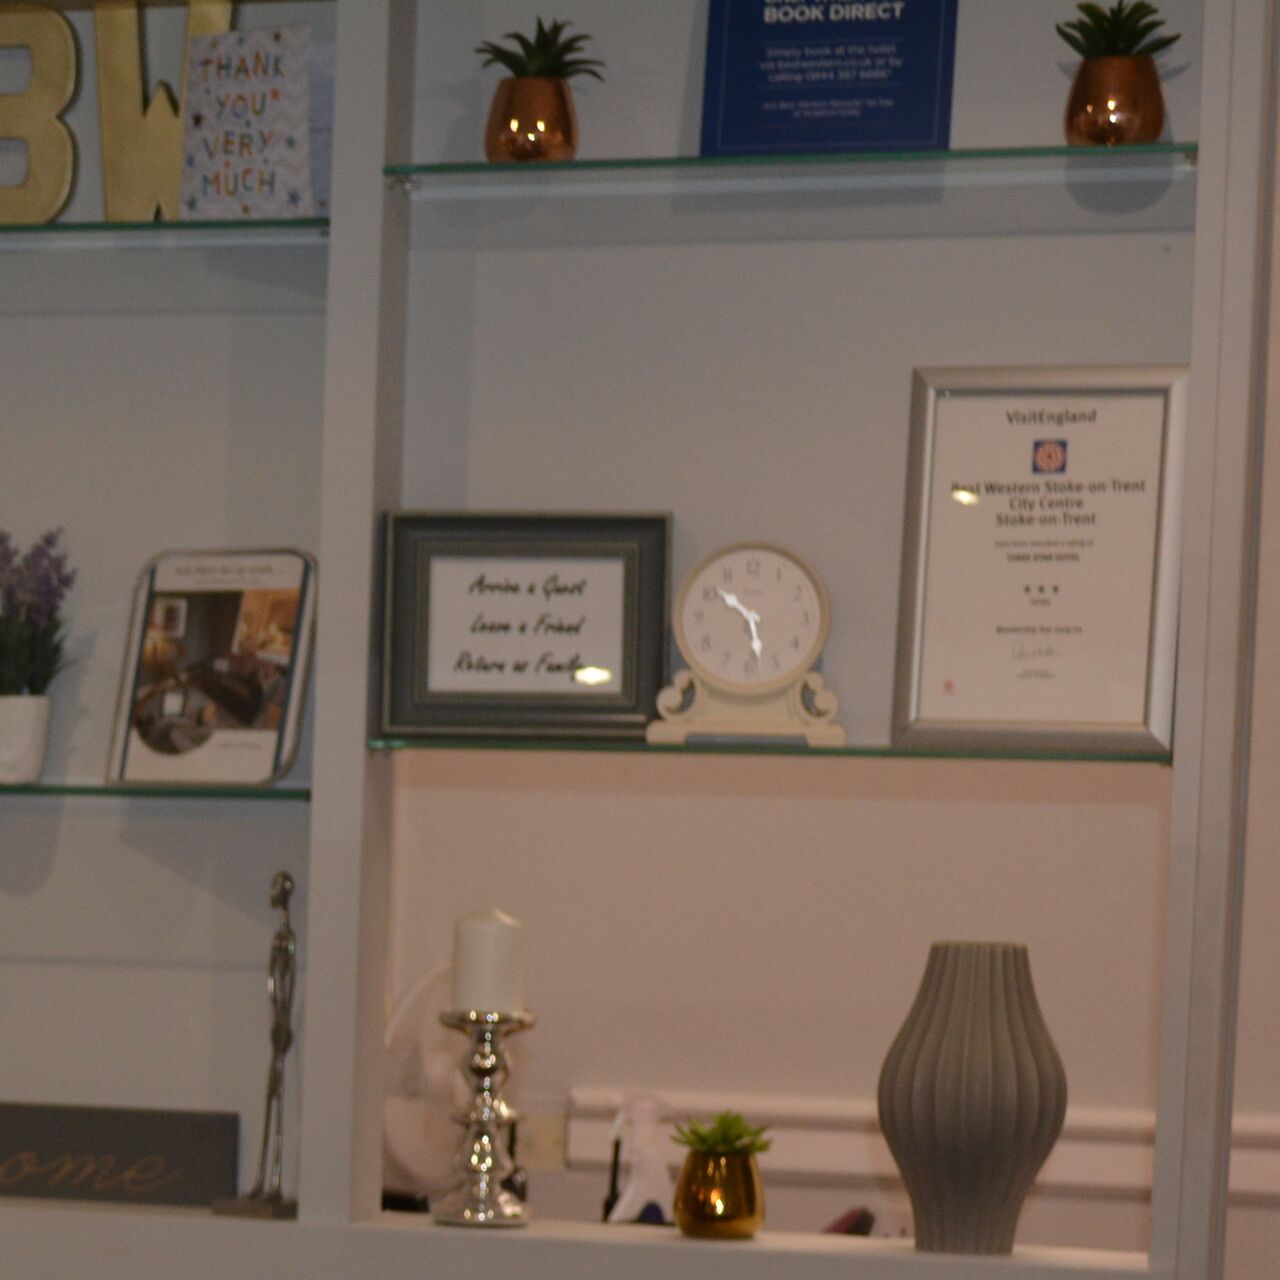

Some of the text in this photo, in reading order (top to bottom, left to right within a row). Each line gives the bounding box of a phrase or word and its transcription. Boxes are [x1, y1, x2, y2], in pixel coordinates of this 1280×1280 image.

[763, 2, 905, 23] BOOK DIRECT
[198, 51, 286, 83] THANK
[216, 91, 267, 120] YOU
[202, 130, 275, 159] VERY
[202, 167, 276, 197] MUCH
[1006, 409, 1097, 427] VisitEngland
[984, 481, 1040, 495] Western
[1044, 478, 1146, 494] Stoke-on-Trent
[1009, 496, 1083, 511] City Centre
[996, 512, 1096, 526] Stoke-on-Trent
[469, 573, 588, 602] Arrive a Guest
[469, 612, 586, 635] Leave a Friend
[453, 650, 505, 673] Return
